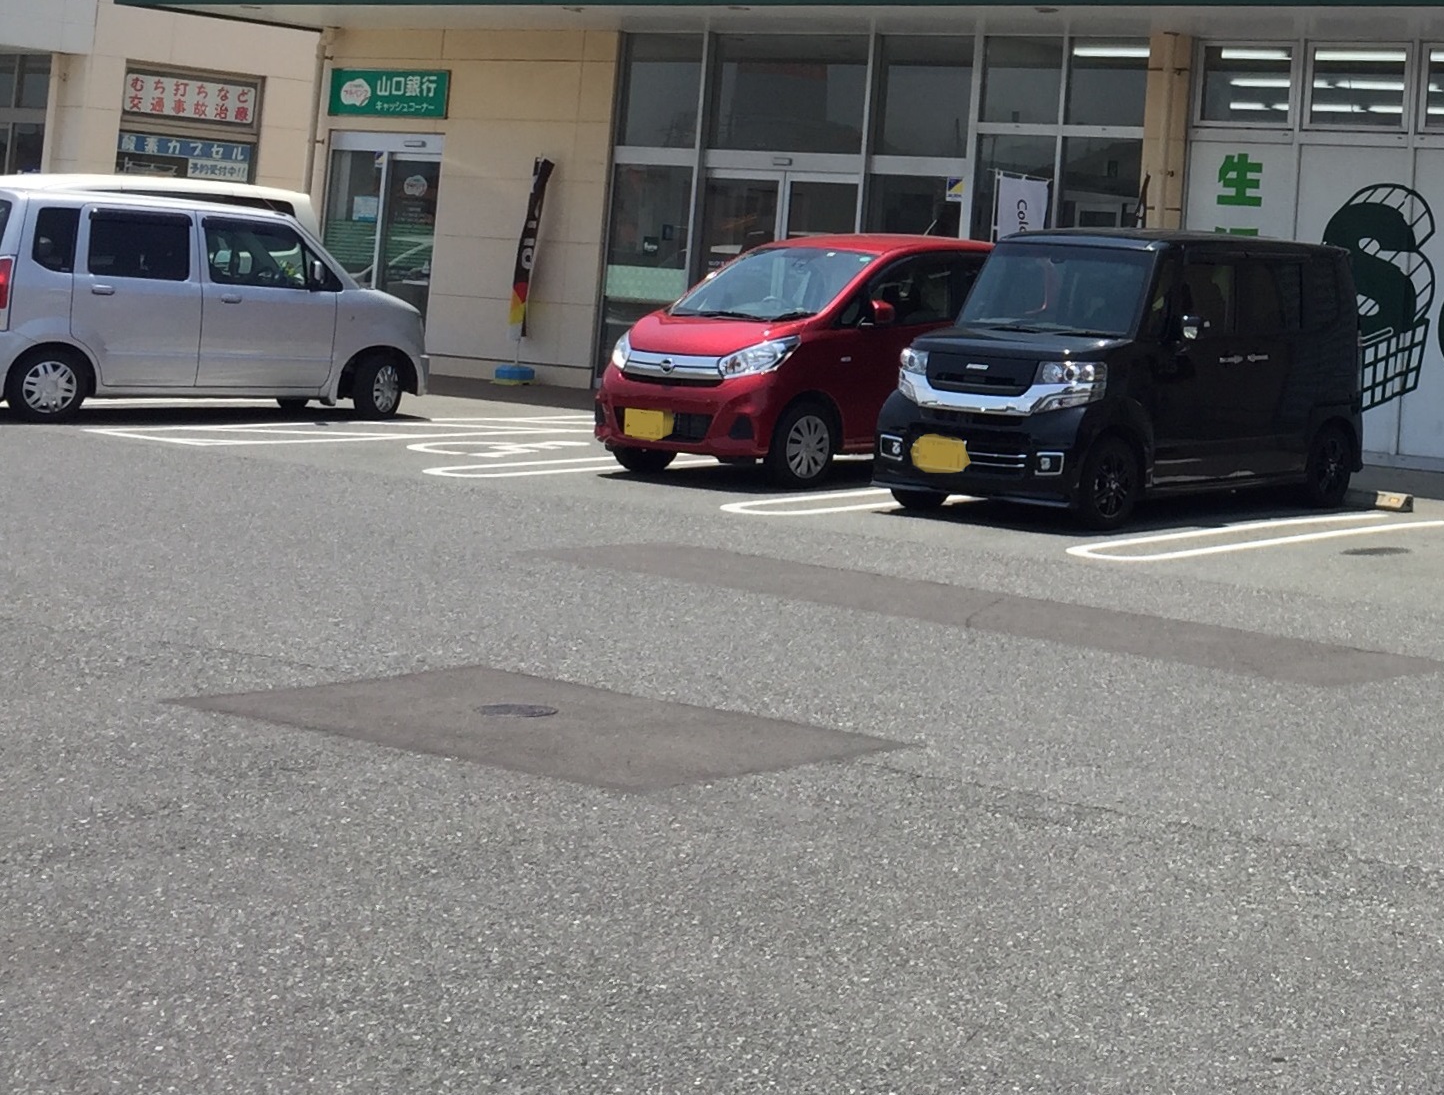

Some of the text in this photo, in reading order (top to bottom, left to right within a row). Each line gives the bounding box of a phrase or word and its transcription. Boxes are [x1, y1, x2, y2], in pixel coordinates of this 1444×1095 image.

[130, 77, 251, 104] むち打ちなど
[376, 75, 437, 97] 山口銀行
[129, 94, 249, 121] 交通事故治療
[375, 100, 435, 113] キャッシュコーナー
[1215, 153, 1263, 236] 生
